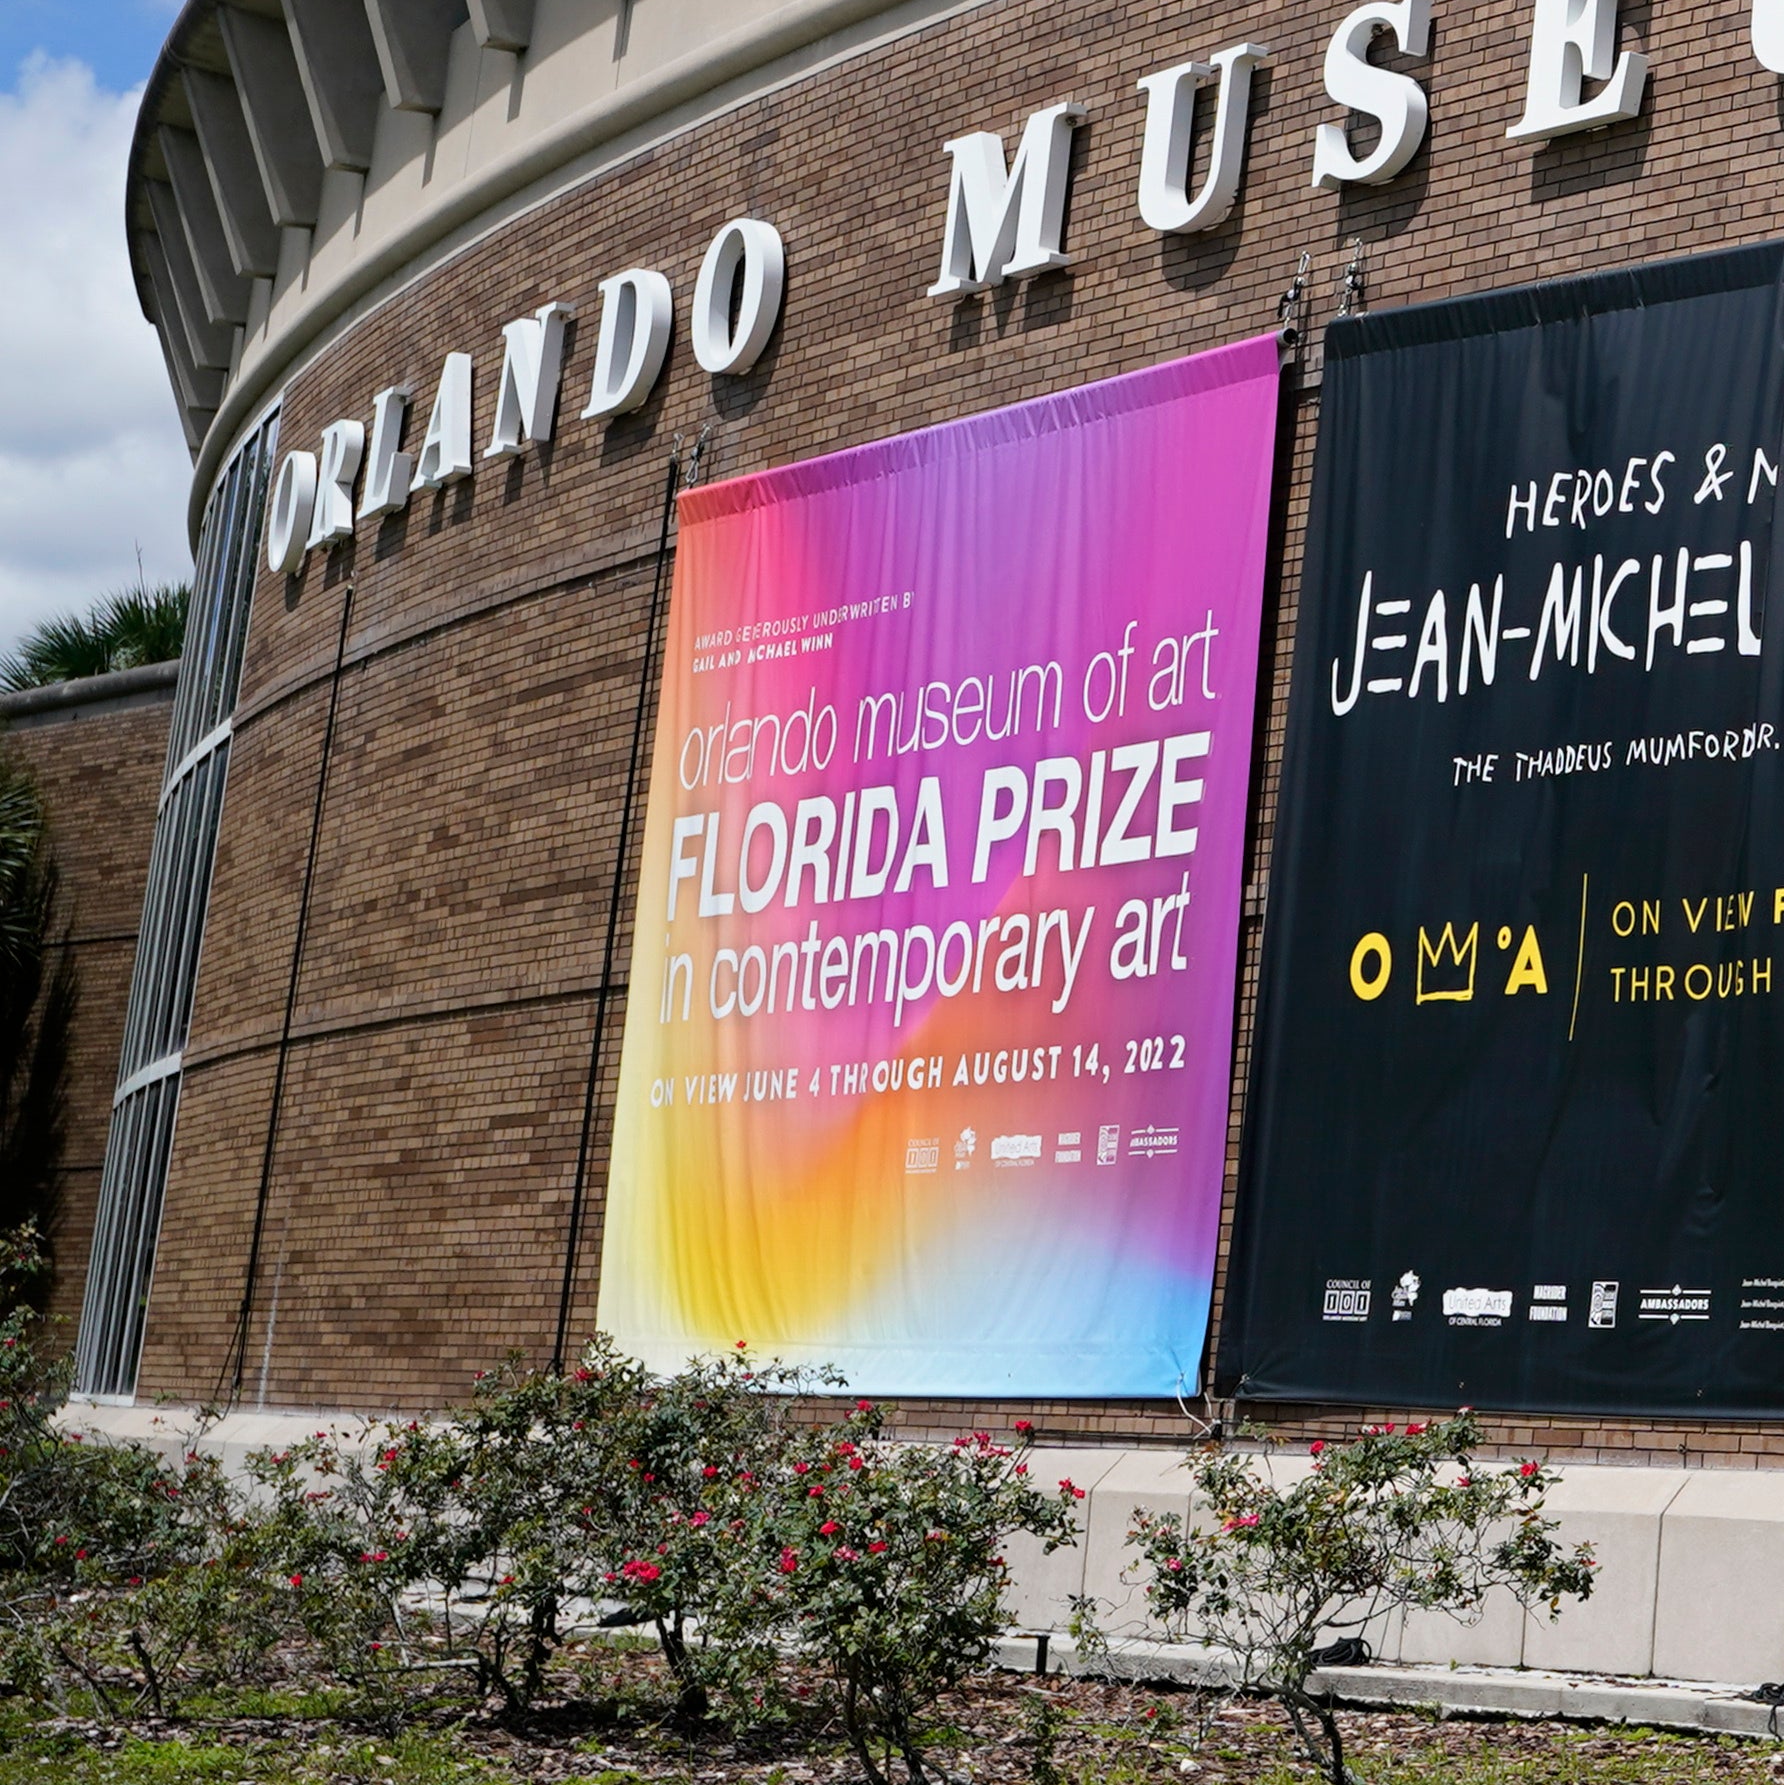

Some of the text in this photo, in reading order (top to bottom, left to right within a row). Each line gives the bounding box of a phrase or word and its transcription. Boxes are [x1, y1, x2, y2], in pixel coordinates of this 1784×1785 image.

[267, 217, 785, 574] ORLANDO
[1505, 450, 1676, 539] HEROES
[1693, 443, 1734, 504] &
[692, 657, 715, 673] GAIL
[718, 649, 741, 669] AND
[801, 632, 833, 654] WINN
[694, 629, 733, 651] AWARD
[1331, 539, 1762, 717] JEAN-MICHEL
[679, 609, 1219, 792] orlando museum of art
[1453, 754, 1499, 786] THE
[1515, 740, 1612, 782] THADDEUS
[667, 731, 1211, 922] FLORIDA PRIZE
[660, 871, 1191, 1028] in contemporary art
[1612, 899, 1661, 937] ON
[1681, 890, 1755, 933] VIEW
[1610, 956, 1772, 1003] THROUGH
[650, 1034, 1186, 1109] ON VIEW JUNE 4 THROUGH AUGUST 14, 2022
[1640, 1298, 1709, 1310] AMBASSADORS
